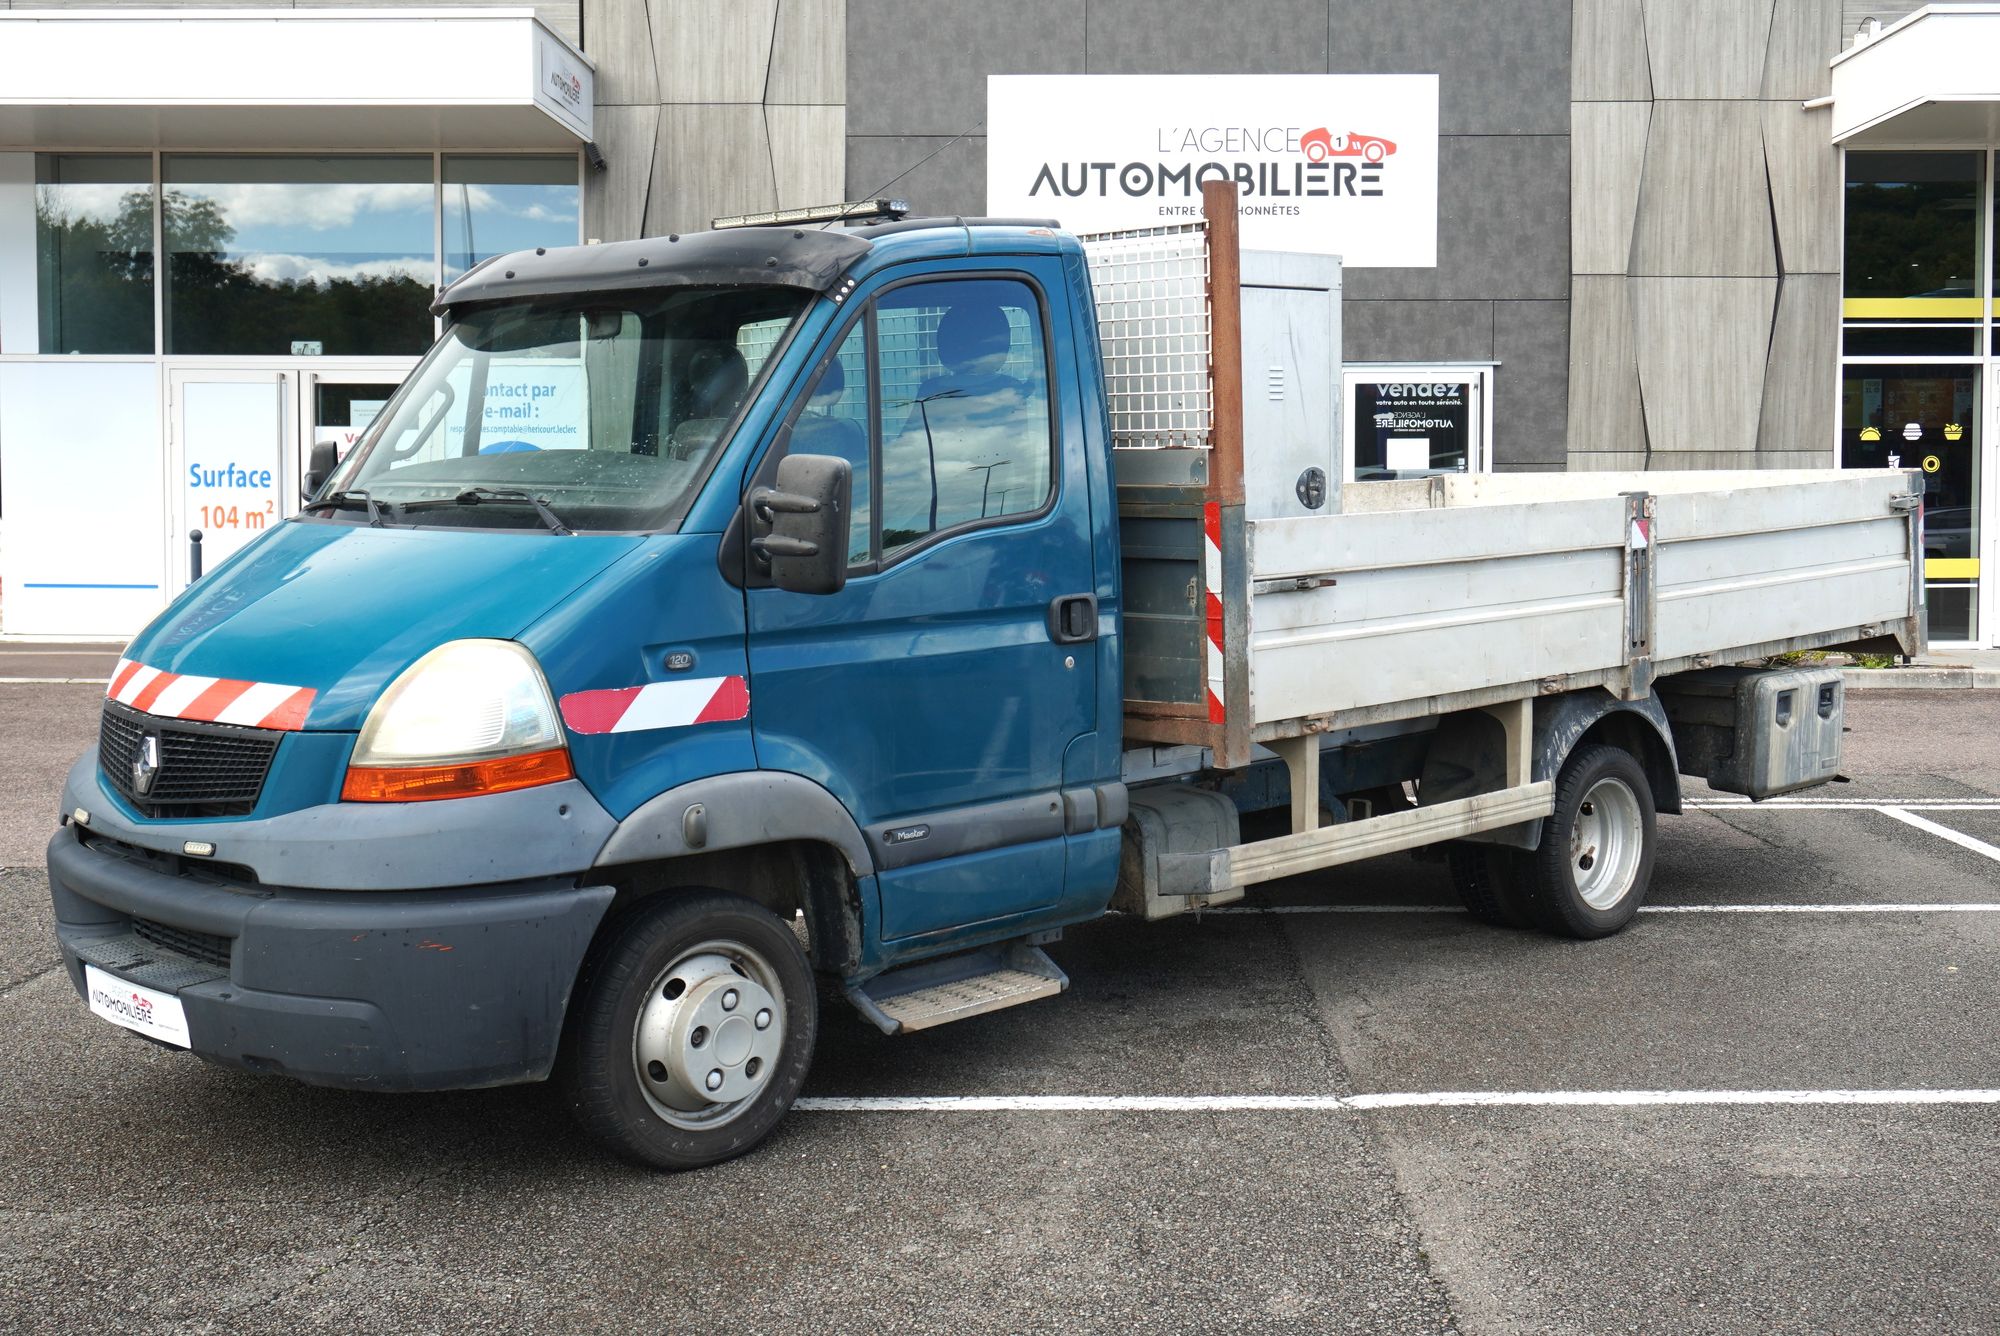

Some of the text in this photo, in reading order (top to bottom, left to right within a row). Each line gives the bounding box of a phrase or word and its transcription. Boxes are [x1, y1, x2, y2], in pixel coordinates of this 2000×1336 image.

[1158, 127, 1301, 153] L'AGENCE
[1158, 206, 1196, 216] ENTRE
[532, 385, 556, 401] par
[485, 403, 531, 418] e-mail
[189, 462, 272, 488] Surface
[200, 505, 240, 529] 104
[669, 654, 689, 665] 120
[897, 828, 926, 841] Master
